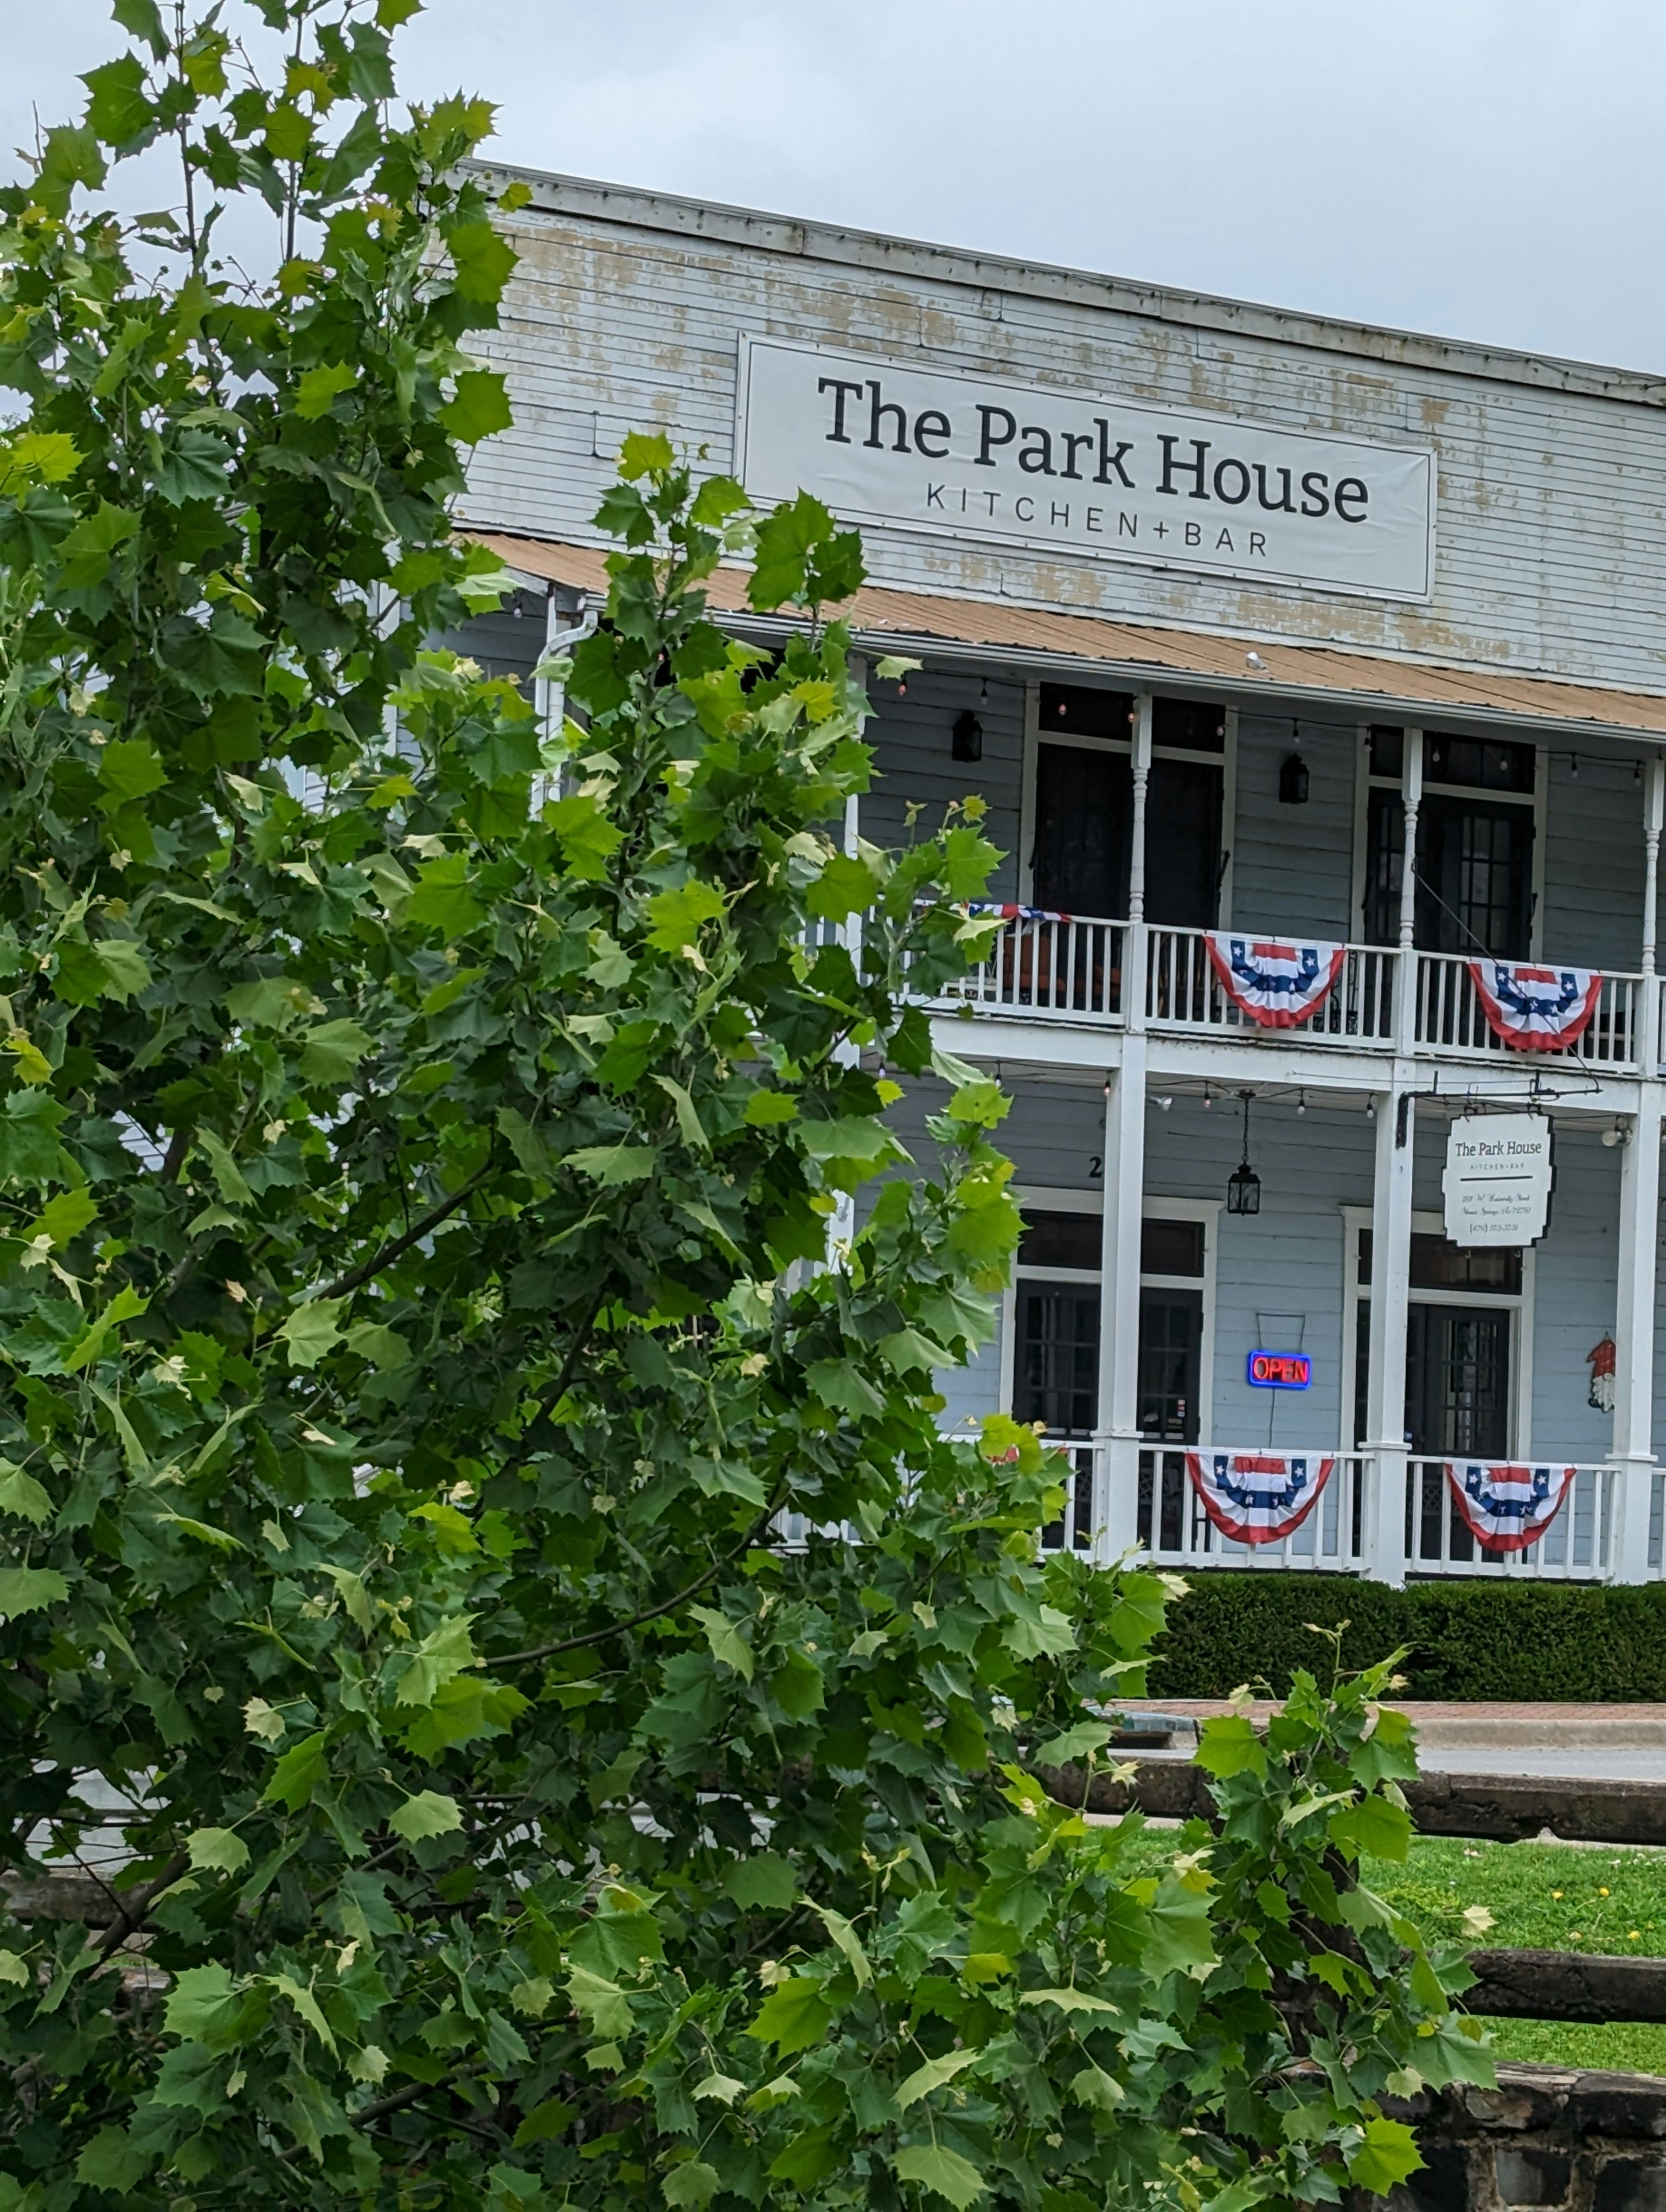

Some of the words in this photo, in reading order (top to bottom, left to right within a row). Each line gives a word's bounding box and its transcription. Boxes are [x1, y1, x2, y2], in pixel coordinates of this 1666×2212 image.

[818, 377, 952, 458] The
[973, 404, 1136, 488] Park
[1156, 434, 1369, 523] House
[1455, 1141, 1476, 1156] The
[1478, 1140, 1504, 1155] Park
[1507, 1141, 1542, 1155] House
[1253, 1356, 1309, 1382] OPEN
